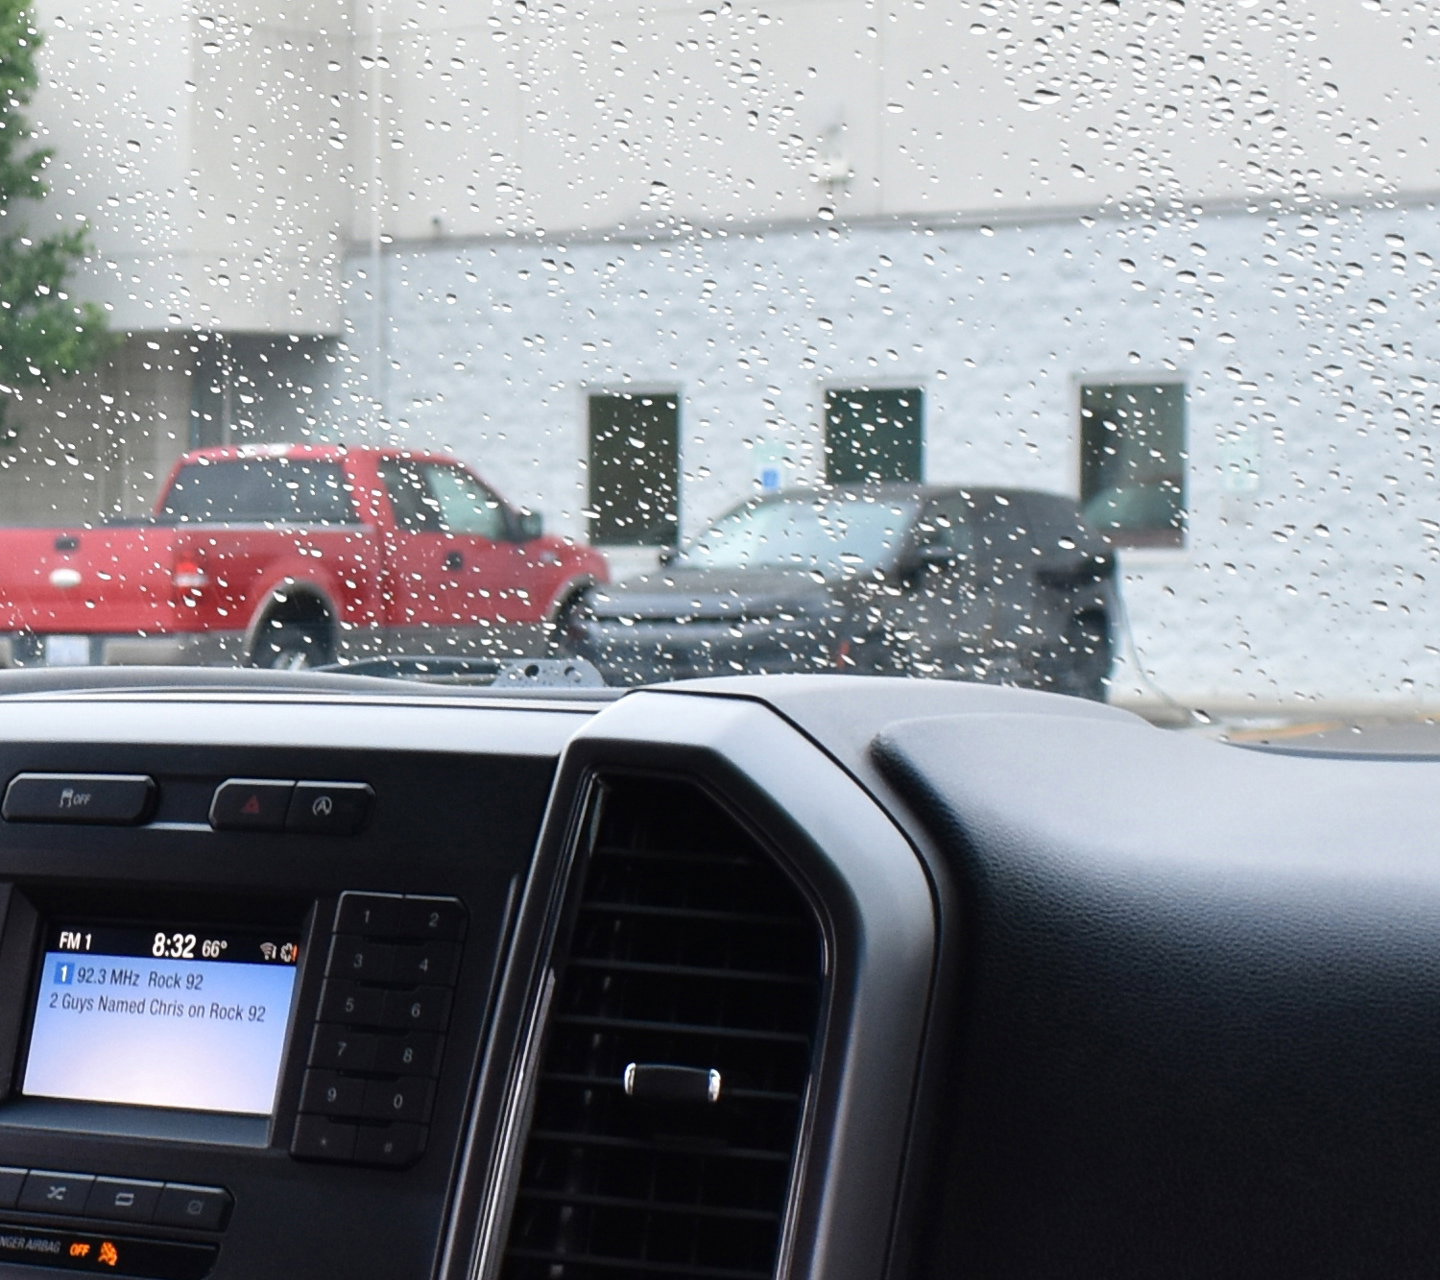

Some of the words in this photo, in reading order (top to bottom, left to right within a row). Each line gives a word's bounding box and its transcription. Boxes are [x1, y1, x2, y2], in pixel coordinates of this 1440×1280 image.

[428, 912, 440, 928] 2
[59, 931, 80, 951] FM
[84, 933, 92, 951] 1
[152, 932, 197, 959] 8:32
[202, 939, 228, 958] 66°
[353, 953, 363, 969] 3
[419, 957, 429, 973] 4
[77, 967, 107, 985] 92.3
[110, 969, 140, 987] MHz
[148, 971, 181, 989] Rock
[186, 973, 204, 991] 92
[49, 992, 58, 1009] 2
[62, 993, 93, 1014] Guys
[98, 996, 145, 1015] Named
[150, 998, 184, 1017] Chris
[188, 1004, 205, 1018] on
[210, 1002, 243, 1021] Rock
[247, 1005, 266, 1022] 92
[345, 997, 355, 1012] 5
[411, 1002, 421, 1018] 6
[337, 1041, 347, 1057] 7
[403, 1047, 413, 1063] 8
[327, 1086, 337, 1102] 9
[393, 1093, 403, 1109] 0
[25, 1236, 62, 1254] AIRBAG
[69, 1241, 92, 1258] OFF
